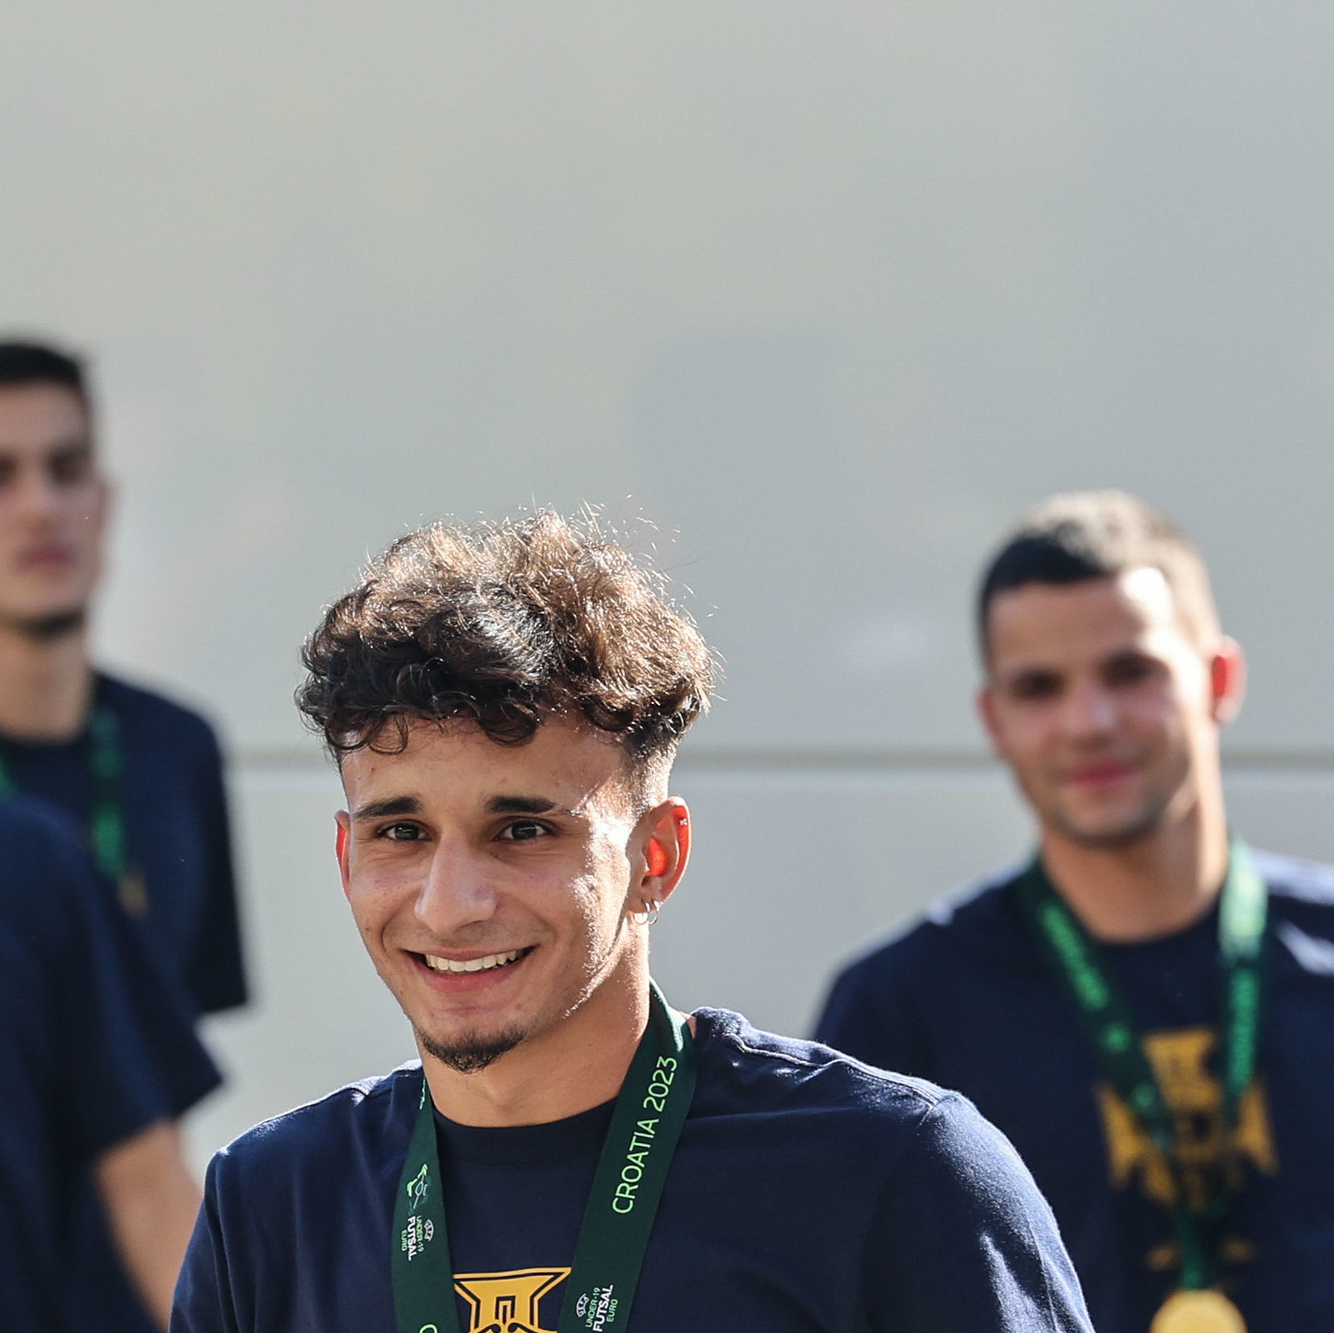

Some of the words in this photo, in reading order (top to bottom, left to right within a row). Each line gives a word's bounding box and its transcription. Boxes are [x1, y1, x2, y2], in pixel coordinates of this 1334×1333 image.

[612, 1118, 660, 1214] CROATIA
[643, 1056, 678, 1112] 2023
[407, 1215, 417, 1261] FUTSAL
[576, 1293, 590, 1318] UEFA
[585, 1287, 601, 1328] UNDER-19
[592, 1284, 614, 1332] FUTSAL
[606, 1298, 618, 1323] EURO
